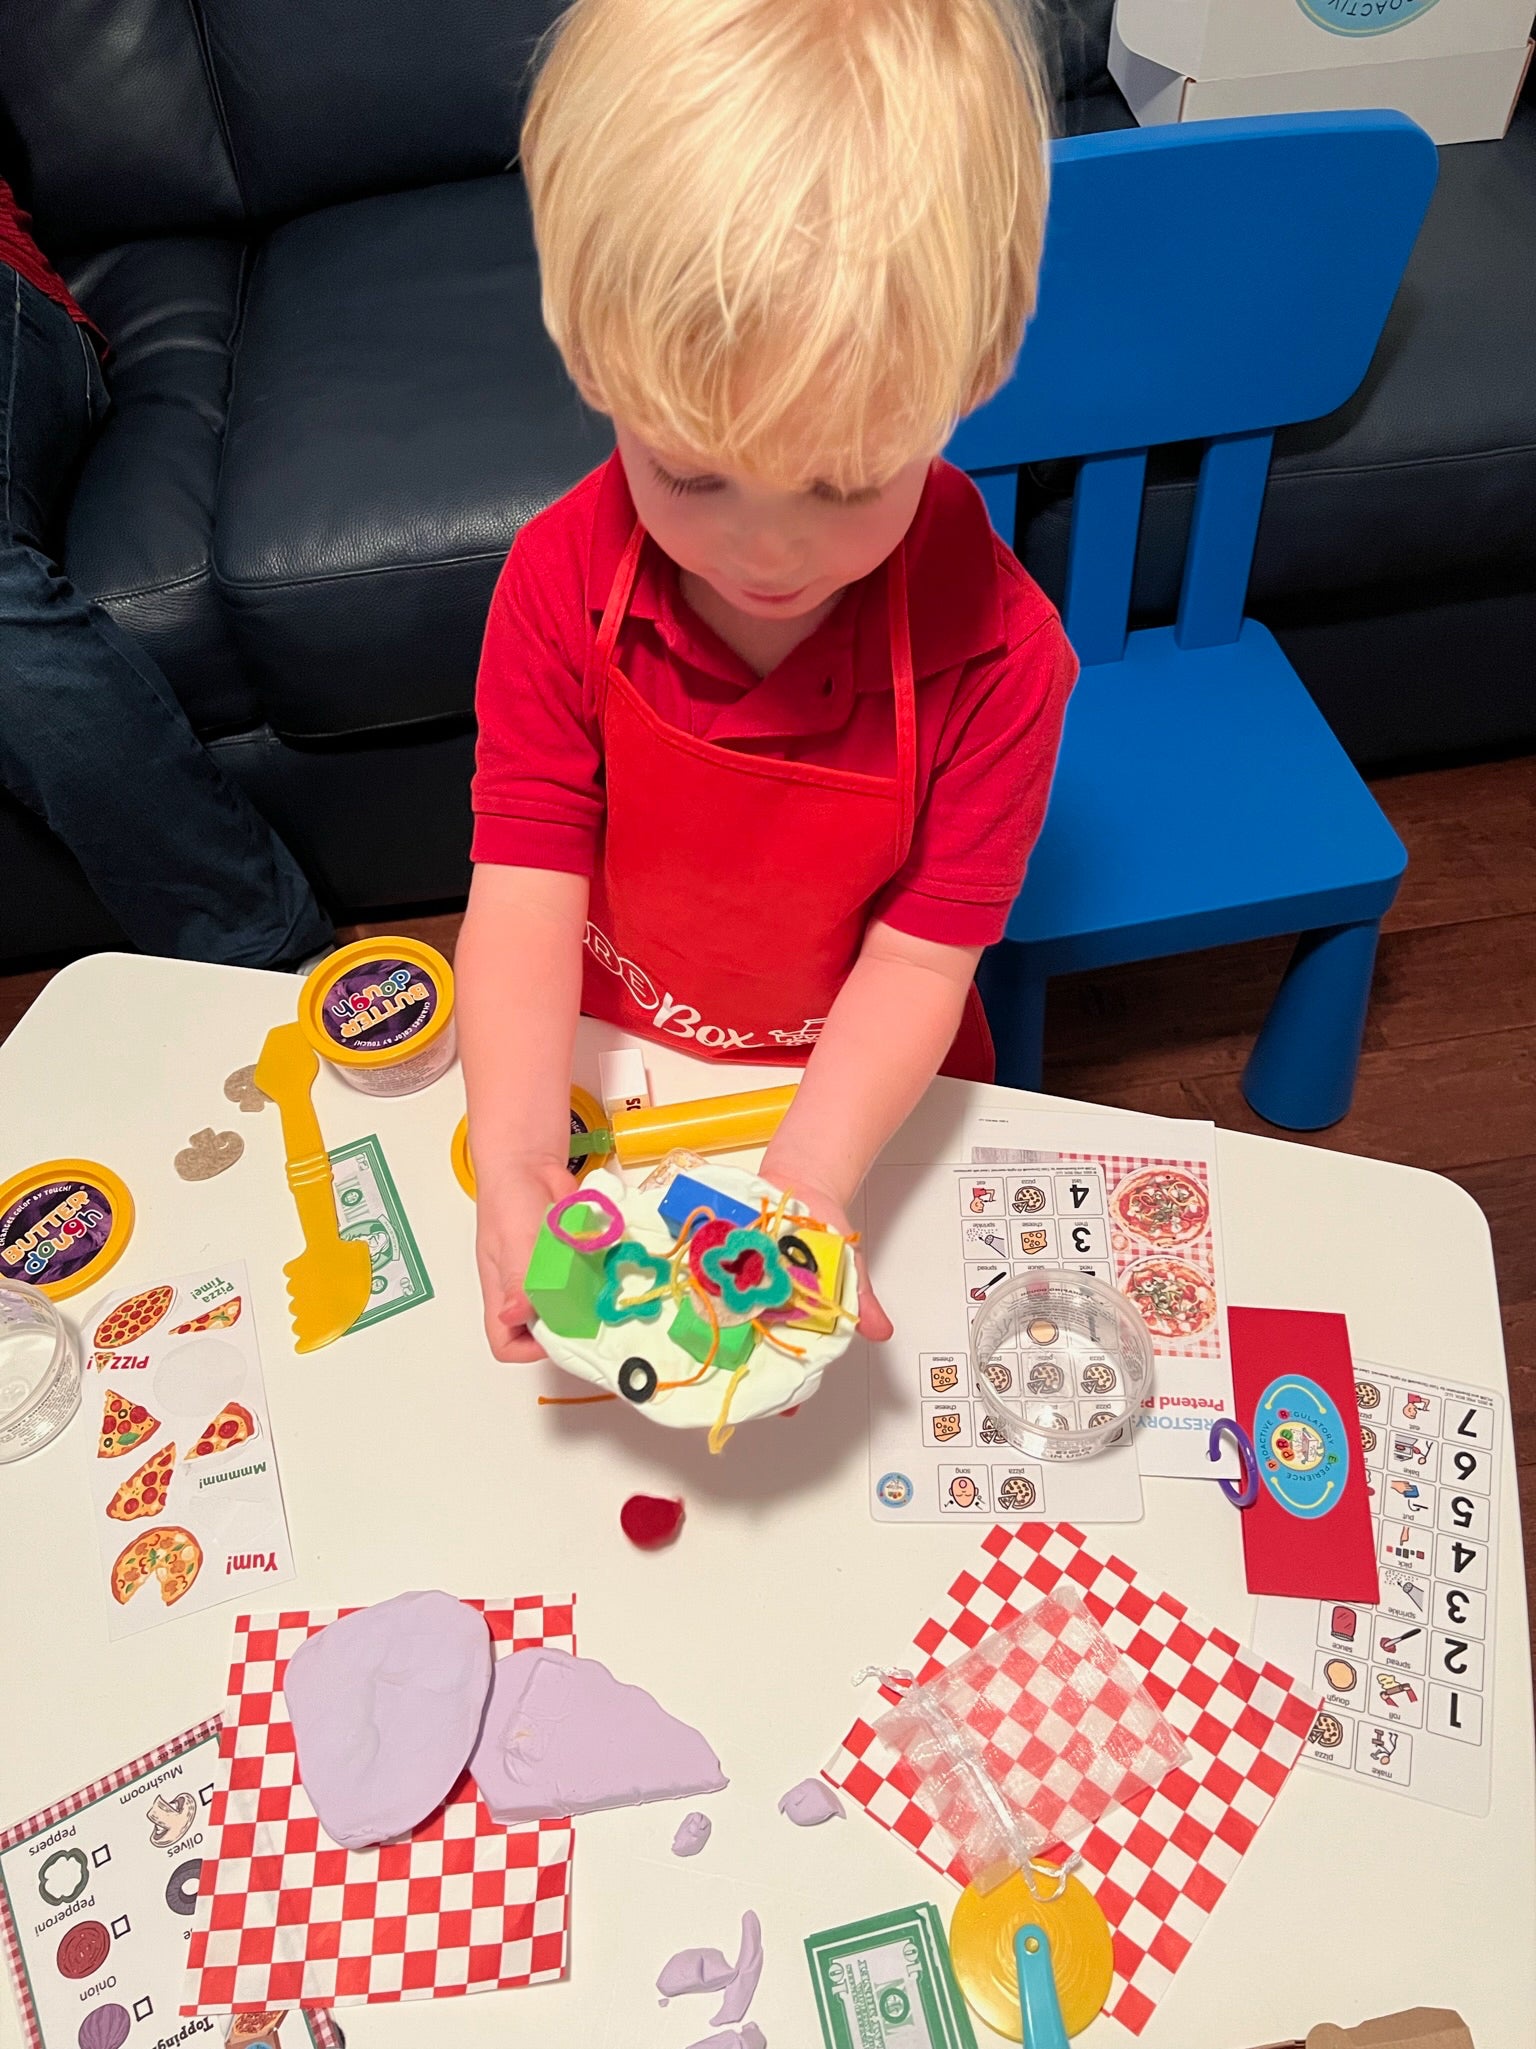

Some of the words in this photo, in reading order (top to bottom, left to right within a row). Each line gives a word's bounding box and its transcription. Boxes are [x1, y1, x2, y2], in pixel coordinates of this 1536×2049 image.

[332, 969, 410, 1017] dough
[340, 983, 429, 1039] BUTTER
[653, 992, 764, 1049] Box
[1069, 1184, 1090, 1209] 4
[1, 1191, 91, 1266] BUTTER
[1072, 1227, 1092, 1253] 3
[24, 1209, 104, 1275] dough
[190, 1275, 226, 1300] Time!
[201, 1281, 235, 1304] Pizza
[1159, 1396, 1224, 1412] Pretend
[1457, 1408, 1478, 1438] 7
[954, 1467, 971, 1475] song
[1008, 1467, 1025, 1475] pizza
[1403, 1467, 1420, 1477] bake
[1454, 1451, 1477, 1481] 6
[1402, 1512, 1415, 1521] put
[1451, 1496, 1475, 1529] 5
[226, 1552, 279, 1575] Yum!
[1397, 1559, 1413, 1569] pick
[1451, 1541, 1477, 1573] 4
[1387, 1606, 1416, 1620] sprinkle
[1446, 1589, 1470, 1624] 3
[1331, 1642, 1353, 1653] sauce
[1444, 1637, 1468, 1675] 2
[1386, 1657, 1411, 1670] spread
[1326, 1694, 1350, 1707] dough
[1449, 1691, 1462, 1729] 1
[1388, 1712, 1401, 1721] roll
[1314, 1751, 1334, 1761] pizza
[119, 1764, 183, 1805] Mushroom
[1371, 1767, 1393, 1779] make
[28, 1825, 76, 1857] Peppers
[167, 1833, 204, 1858] Olives
[34, 1895, 96, 1937] Pepperoni
[79, 1975, 117, 2001] Onion
[152, 2016, 214, 2049] Topping
